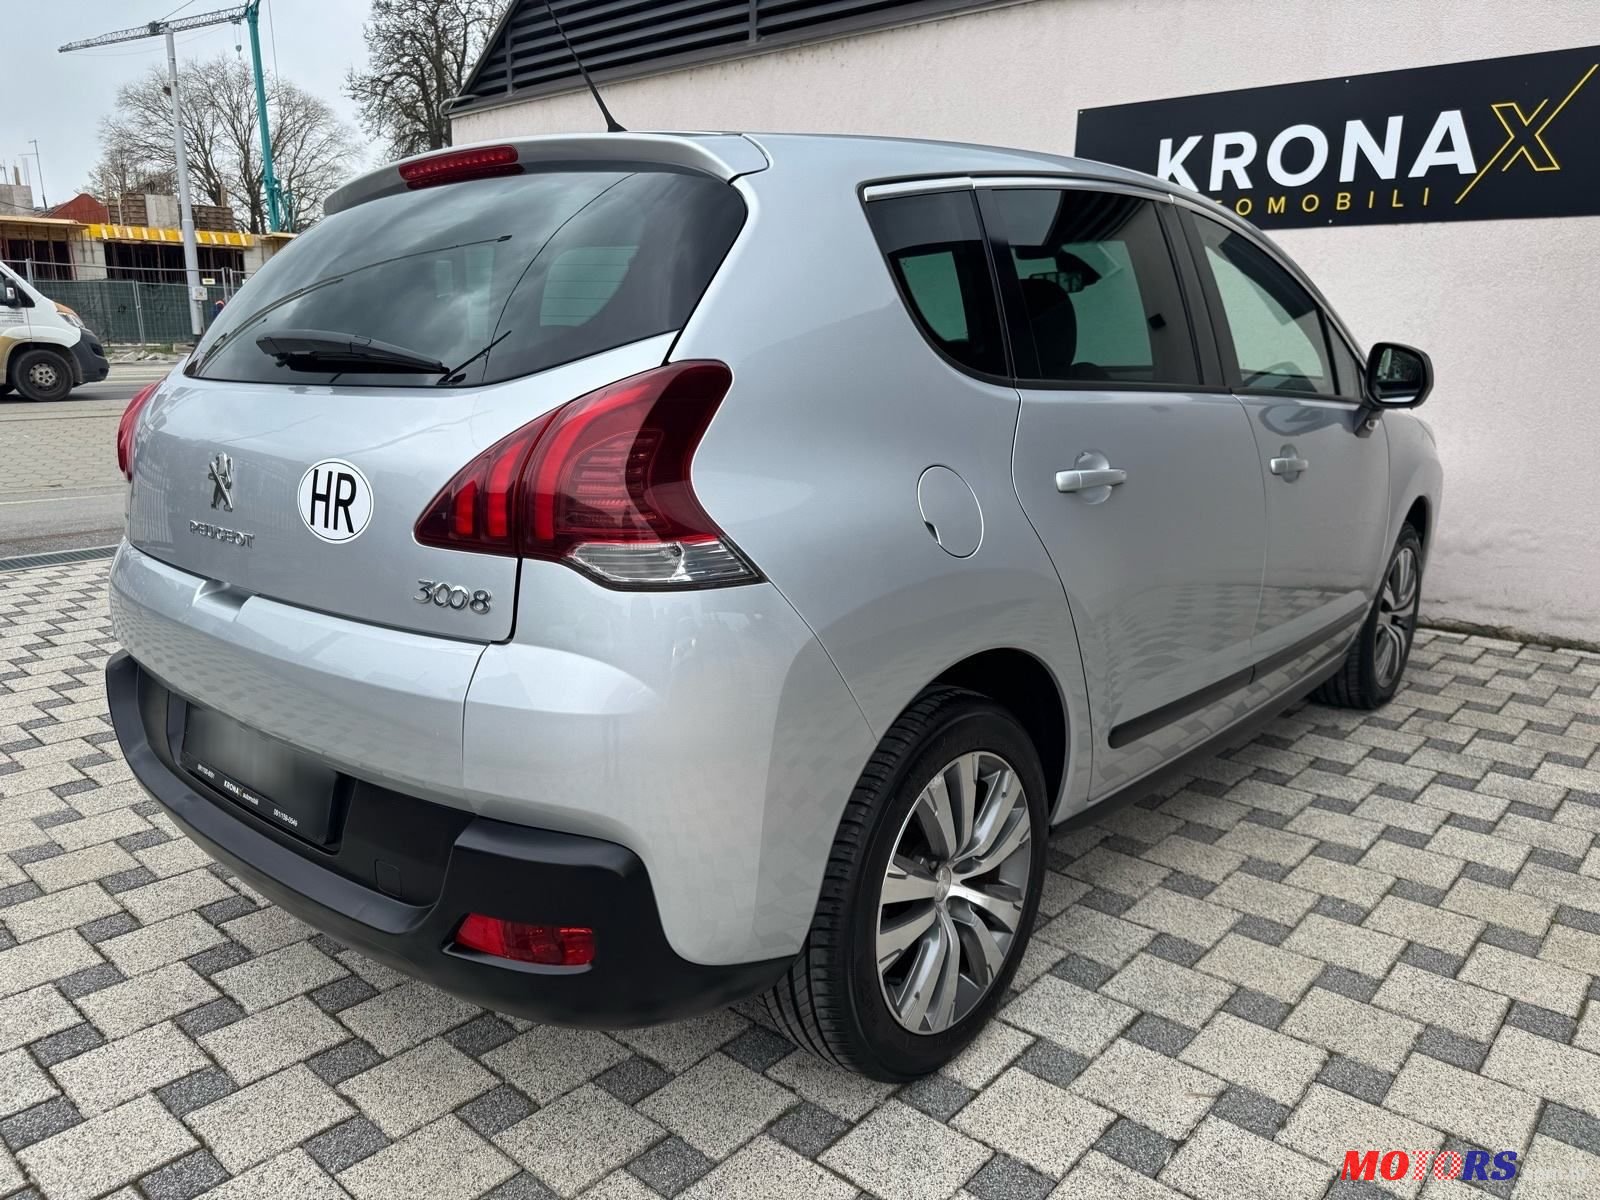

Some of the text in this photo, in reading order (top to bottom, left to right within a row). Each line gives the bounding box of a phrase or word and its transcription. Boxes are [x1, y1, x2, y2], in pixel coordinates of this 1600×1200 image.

[1215, 187, 1430, 216] OMOBILI
[310, 468, 357, 534] HR
[189, 519, 255, 549] PEUGEOT
[413, 577, 492, 615] 3008
